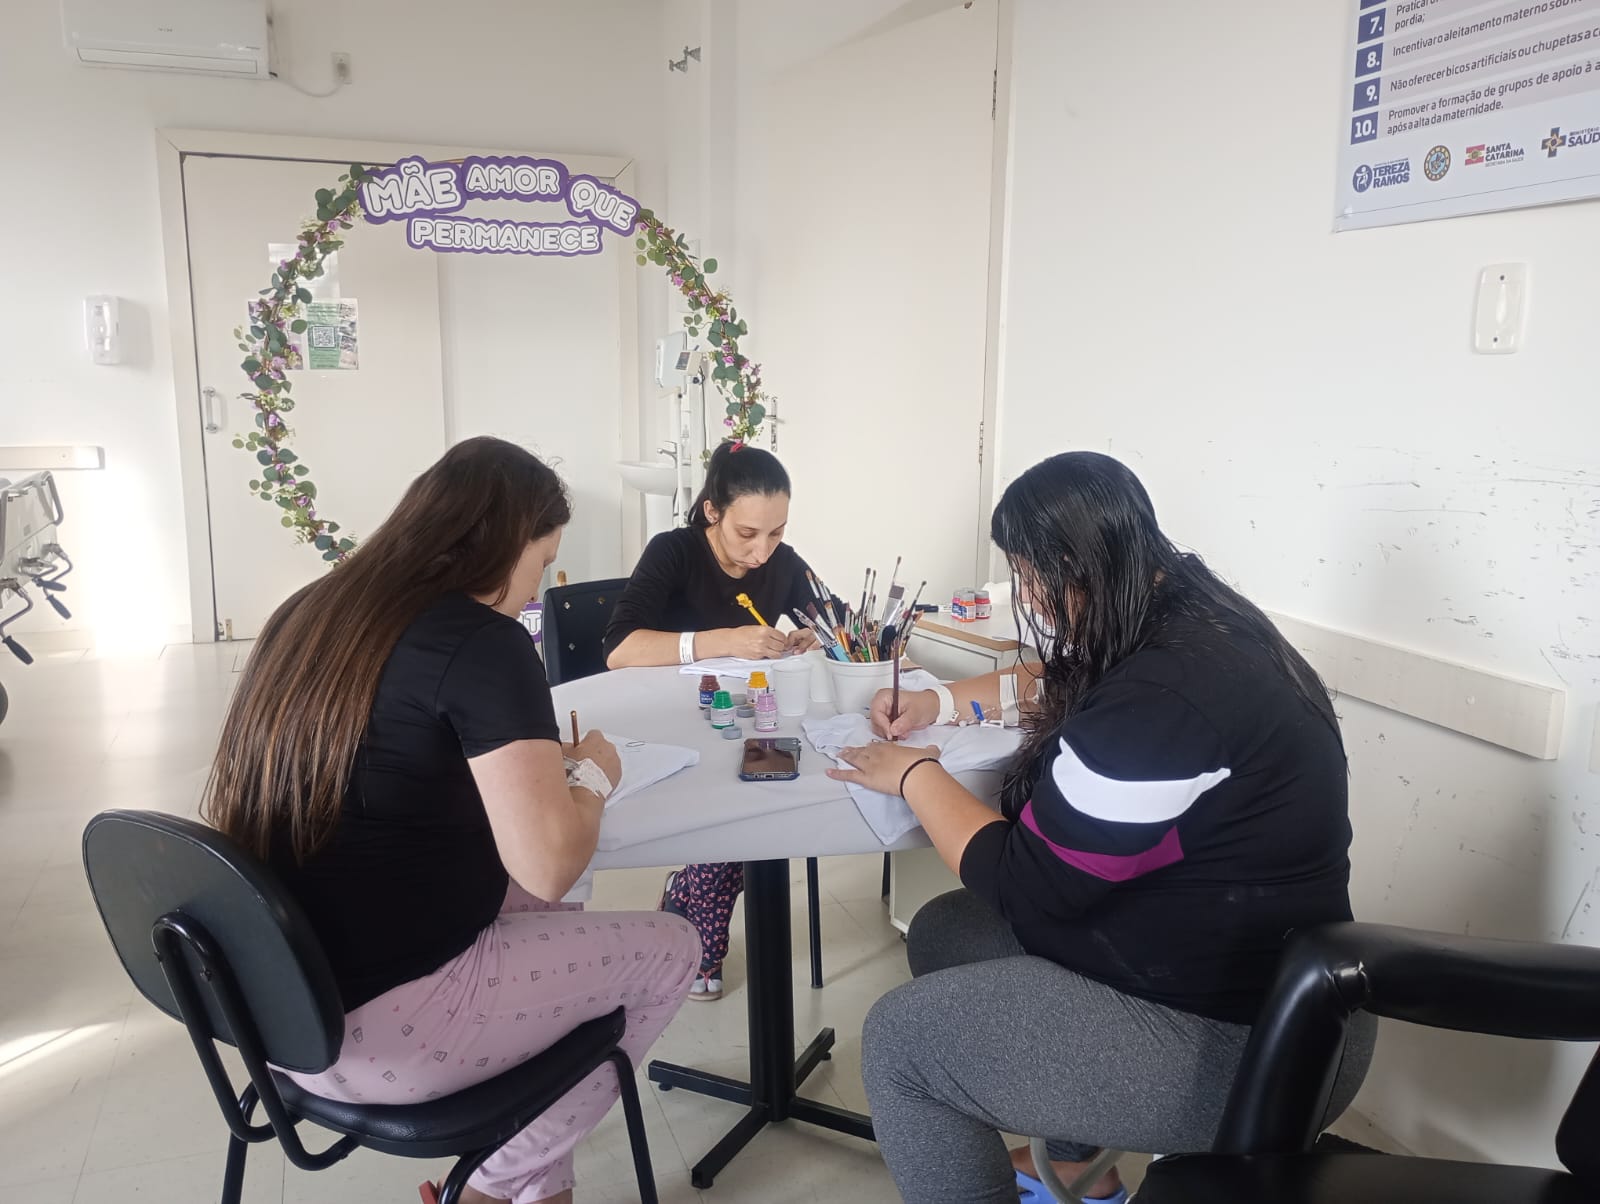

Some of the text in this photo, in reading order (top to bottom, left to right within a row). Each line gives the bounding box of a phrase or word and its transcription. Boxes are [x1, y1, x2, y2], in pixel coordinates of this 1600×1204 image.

[1370, 16, 1383, 34] 7.
[1393, 36, 1438, 56] Incentivar
[1444, 17, 1502, 41] aleitamento
[1502, 3, 1548, 24] materno
[1366, 51, 1380, 68] 8.
[1390, 79, 1408, 92] Não
[1408, 70, 1445, 87] oferecer
[1446, 63, 1470, 76] bicos
[1471, 49, 1516, 70] artificiais
[1518, 46, 1531, 58] ou
[1532, 32, 1584, 54] chupetas
[1584, 30, 1591, 40] a
[1366, 85, 1378, 102] 9.
[1388, 102, 1430, 120] Promover
[1431, 102, 1436, 110] a
[1438, 90, 1482, 108] formação
[1484, 86, 1496, 96] de
[1498, 78, 1533, 96] grupos
[1536, 72, 1550, 84] de
[1552, 64, 1582, 82] apoio
[1388, 121, 1408, 136] após
[1442, 99, 1504, 122] maternidade.
[1354, 119, 1376, 138] 10.
[1485, 148, 1524, 162] CATARINA
[1486, 142, 1512, 154] SANTA
[1373, 161, 1410, 178] TEREZA
[1373, 172, 1410, 188] RAMOS
[364, 162, 637, 229] MÃE AMOR QUE
[411, 218, 601, 252] PERMANECE
